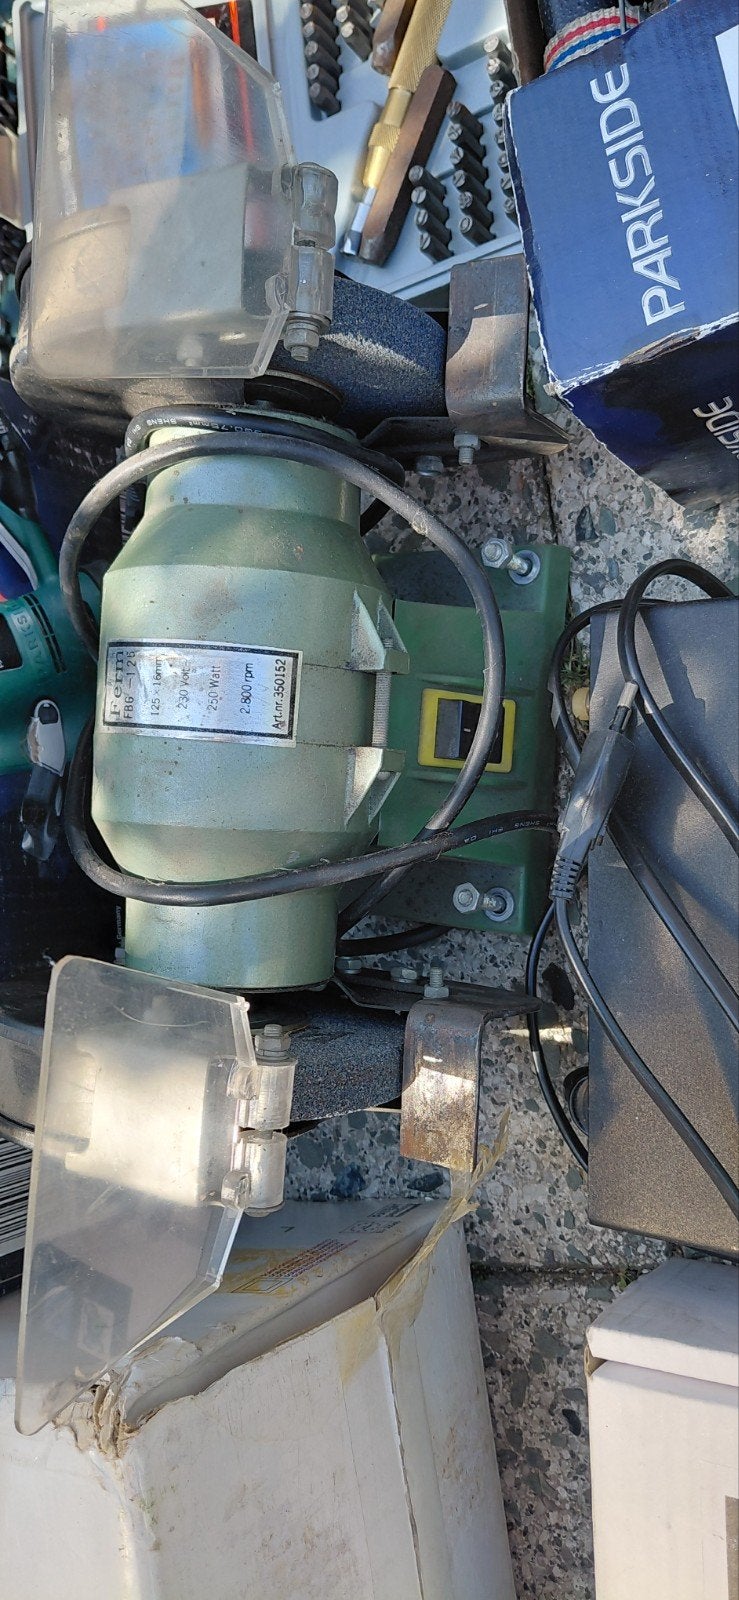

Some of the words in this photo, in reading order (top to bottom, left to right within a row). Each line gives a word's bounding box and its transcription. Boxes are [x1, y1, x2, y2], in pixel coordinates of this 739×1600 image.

[590, 63, 686, 326] PARKSIDE
[109, 650, 124, 717] Ferm
[209, 665, 222, 688] Watt
[243, 662, 255, 683] rpm
[123, 695, 134, 719] FBG
[150, 698, 161, 716] 125
[177, 689, 190, 710] 230
[206, 690, 219, 711] 250
[239, 684, 252, 714] 2.800
